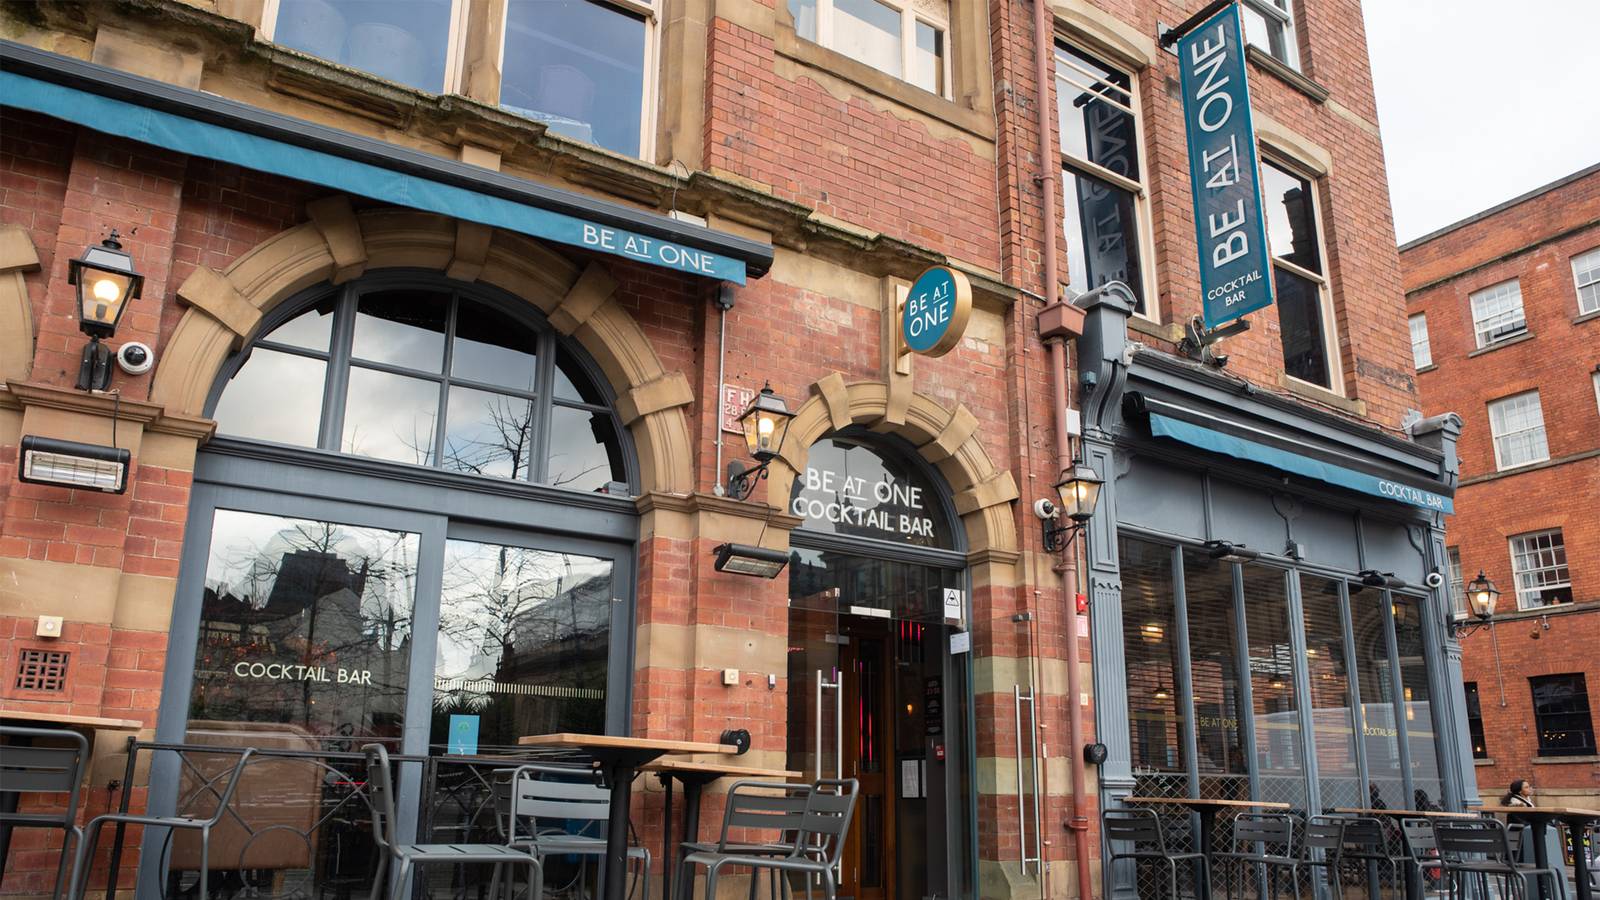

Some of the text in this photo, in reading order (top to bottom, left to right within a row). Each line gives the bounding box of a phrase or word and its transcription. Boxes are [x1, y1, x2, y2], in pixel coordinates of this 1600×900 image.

[1191, 24, 1249, 269] BE AT ONE
[583, 224, 716, 274] BE AT ONE
[910, 280, 949, 316] BE AT
[1207, 270, 1262, 301] COCKTAIL
[1225, 290, 1246, 307] BAR
[910, 301, 949, 336] ONE
[806, 467, 923, 509] BE AT ONE
[1378, 481, 1444, 509] COCKTAIL BAR
[792, 497, 934, 537] COCKTAIL BAR
[234, 661, 372, 685] COCKTAIL BAR
[1200, 717, 1238, 729] BE AT ONE
